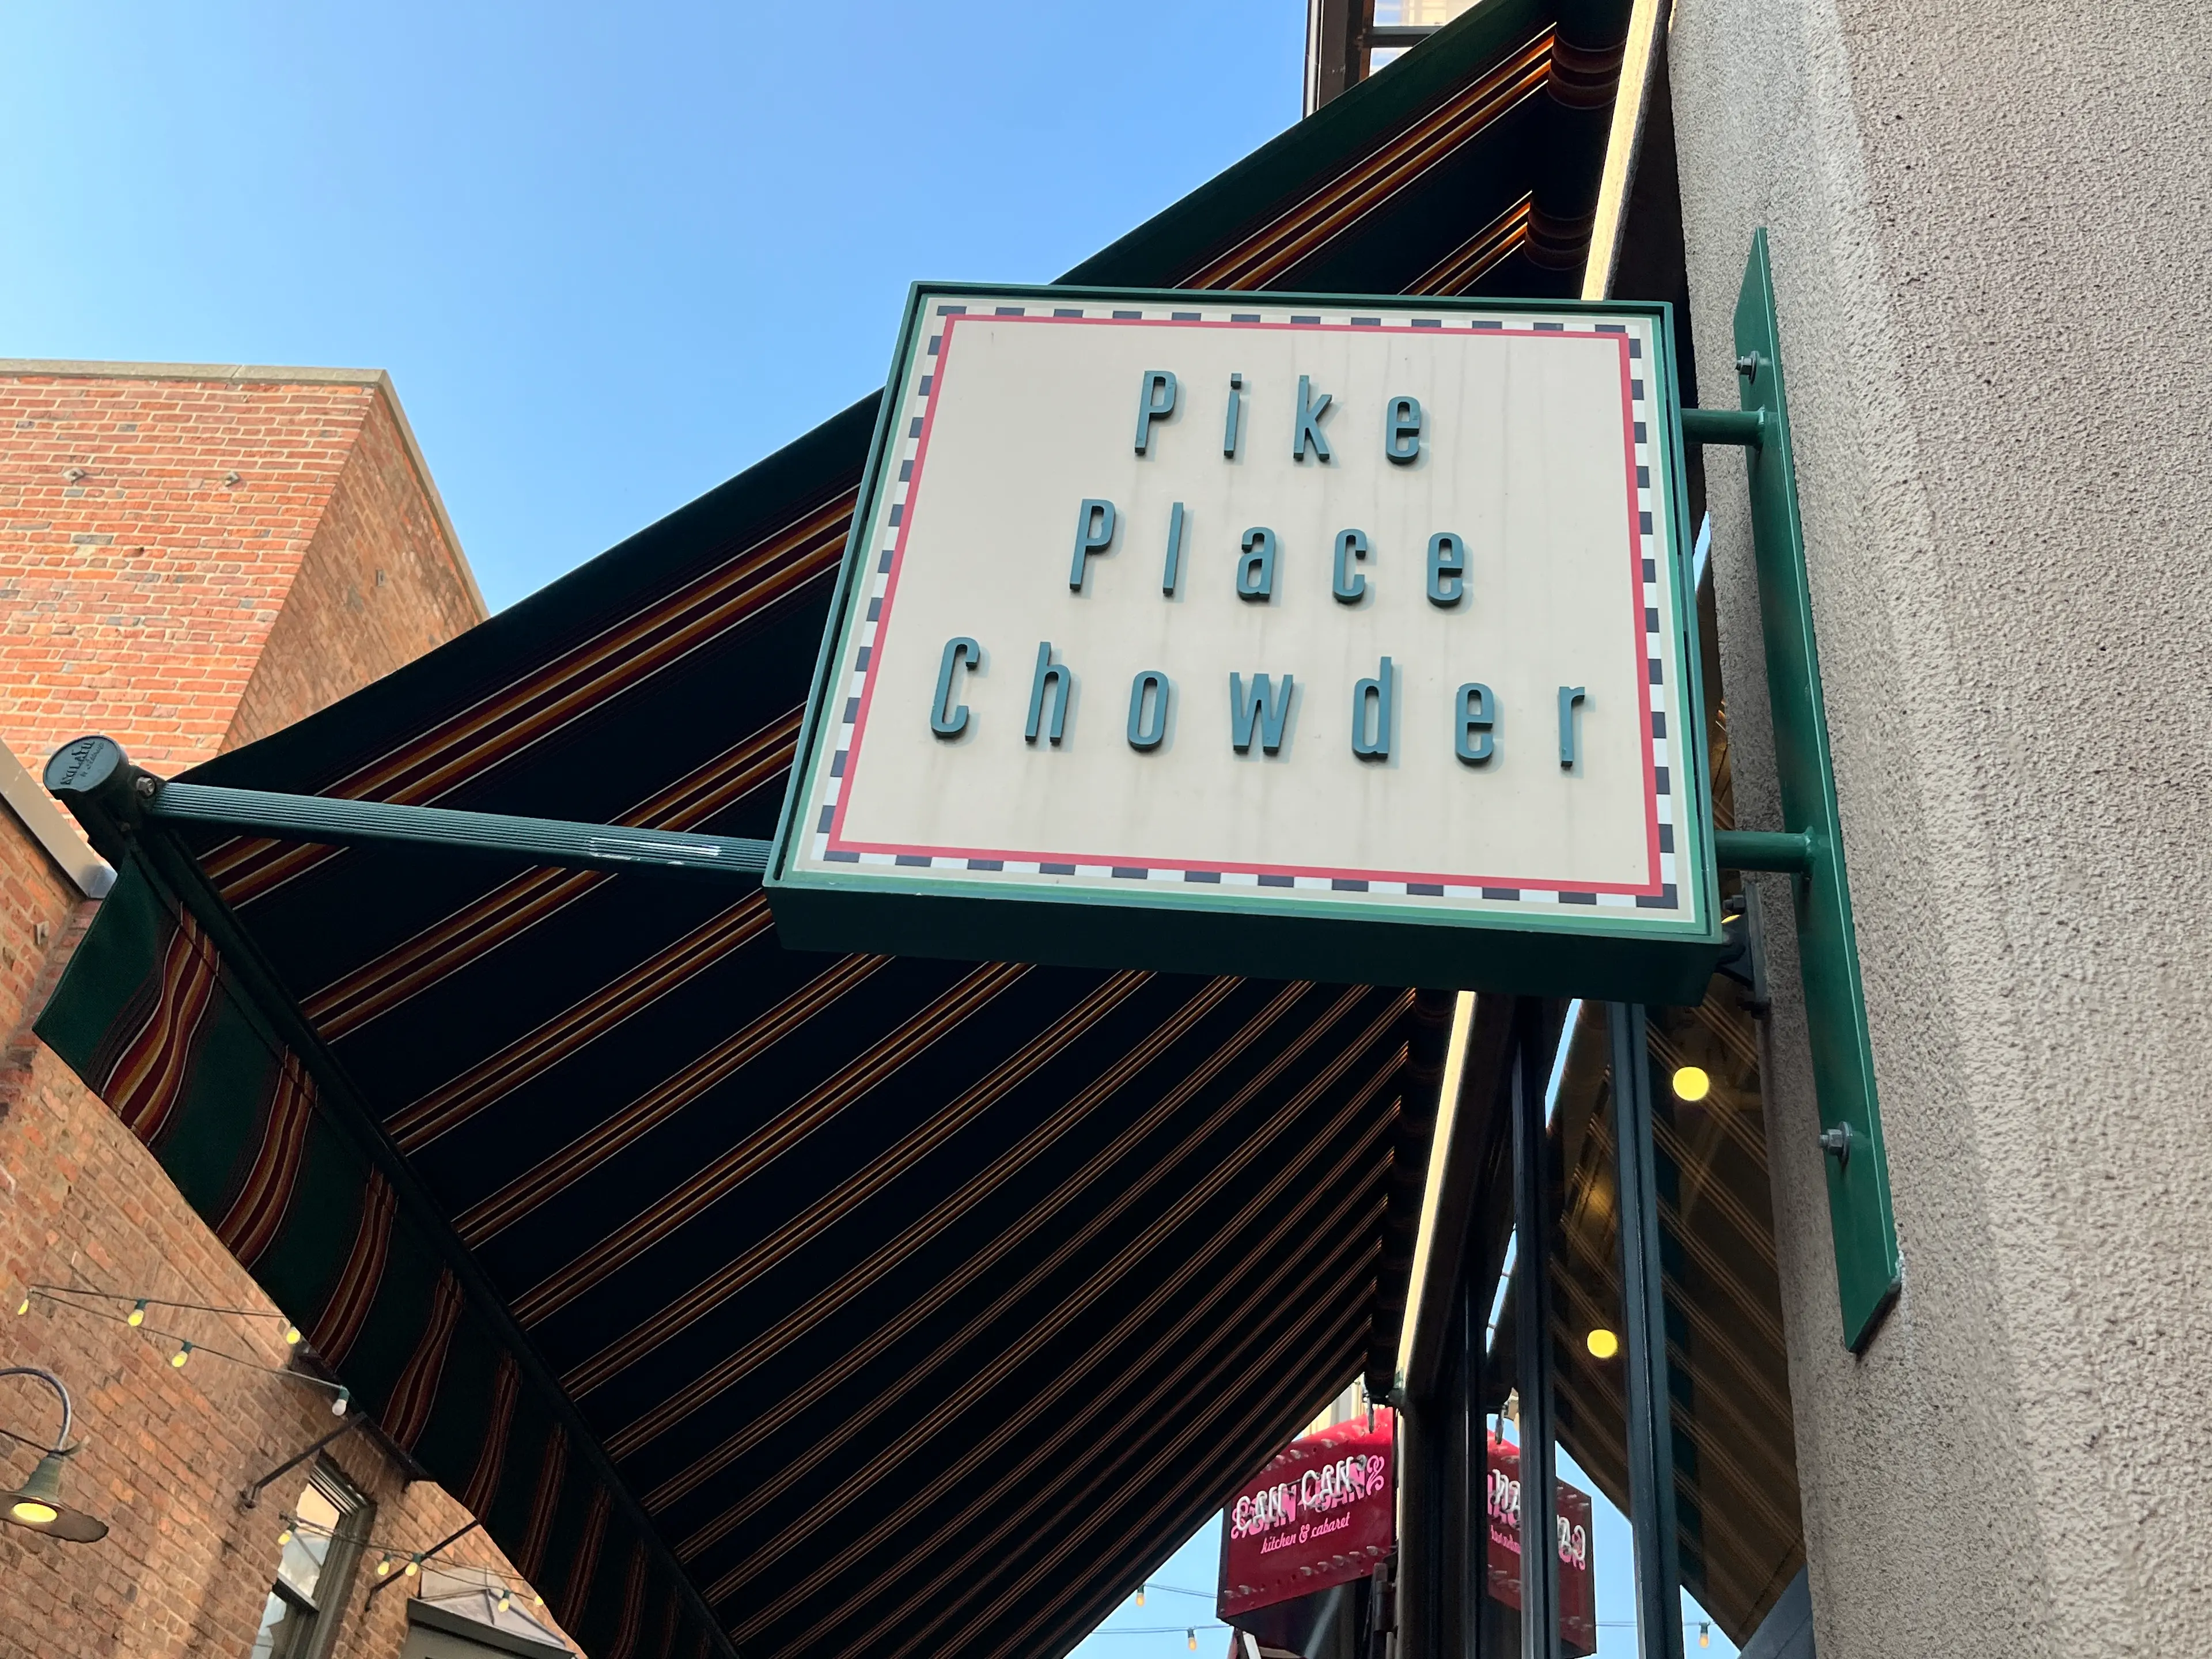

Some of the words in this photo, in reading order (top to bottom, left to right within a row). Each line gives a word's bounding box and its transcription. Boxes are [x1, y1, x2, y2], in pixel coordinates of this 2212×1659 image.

[1134, 370, 1422, 468] Pike
[1069, 499, 1465, 611] Place
[930, 637, 1585, 772] Chowder
[1231, 1483, 1296, 1539] CAN
[1298, 1456, 1366, 1513] CAN
[1260, 1532, 1296, 1554] kitchen
[1298, 1523, 1310, 1544] &
[1310, 1512, 1351, 1539] cabaret
